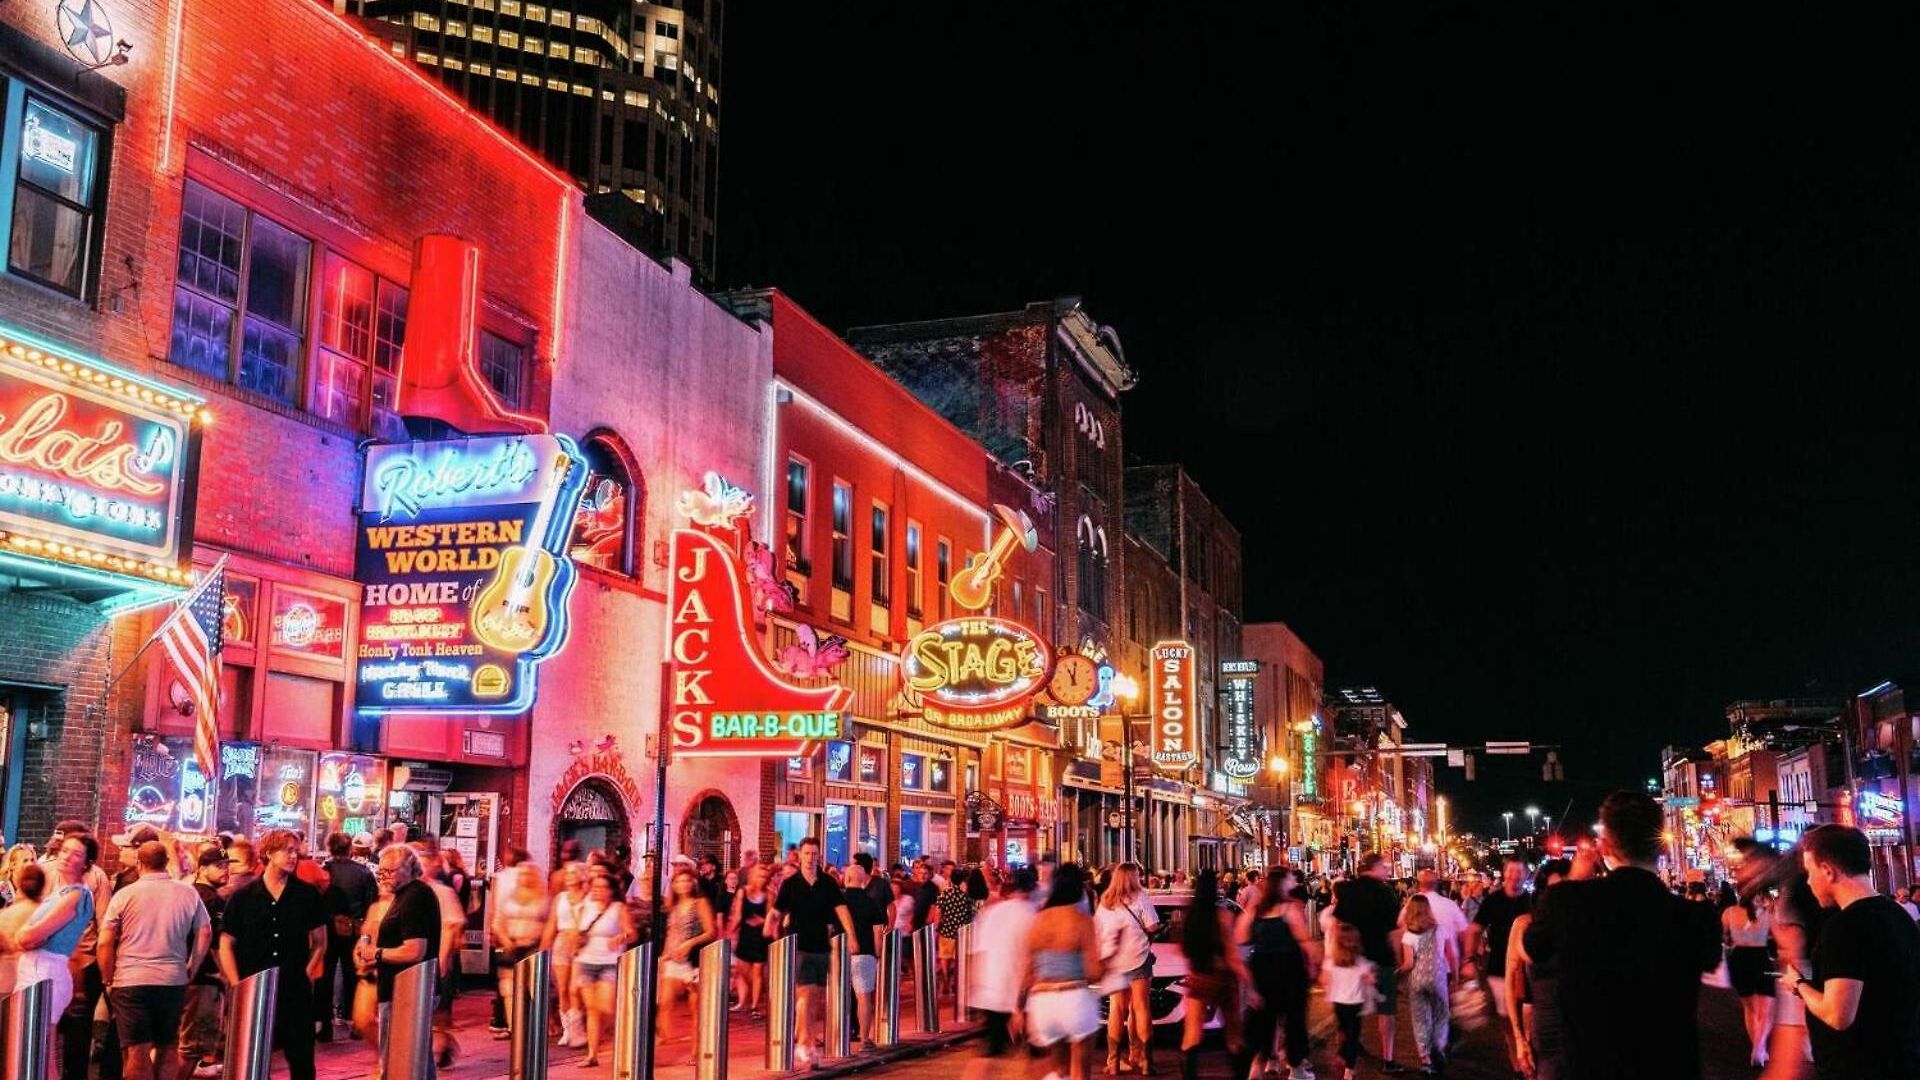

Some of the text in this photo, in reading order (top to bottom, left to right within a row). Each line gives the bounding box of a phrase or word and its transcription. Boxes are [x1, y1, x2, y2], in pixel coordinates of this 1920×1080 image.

[0, 393, 164, 495] la's
[378, 441, 538, 522] Robert's
[366, 520, 525, 548] WESTERN
[385, 547, 499, 574] WORLD
[364, 577, 484, 608] HOME of
[960, 621, 989, 635] THE
[358, 642, 484, 660] Honky Tonk Heaven
[672, 547, 714, 747] JACKS
[1156, 648, 1189, 660] LUCKY
[910, 632, 1044, 692] STAGE
[948, 706, 1024, 726] BROADWAY
[1047, 706, 1100, 718] BOOTS
[1162, 659, 1184, 752] SALOON
[711, 713, 839, 739] BAR-B-QUE
[1232, 679, 1248, 760] WHISKEY
[1228, 759, 1256, 776] Row
